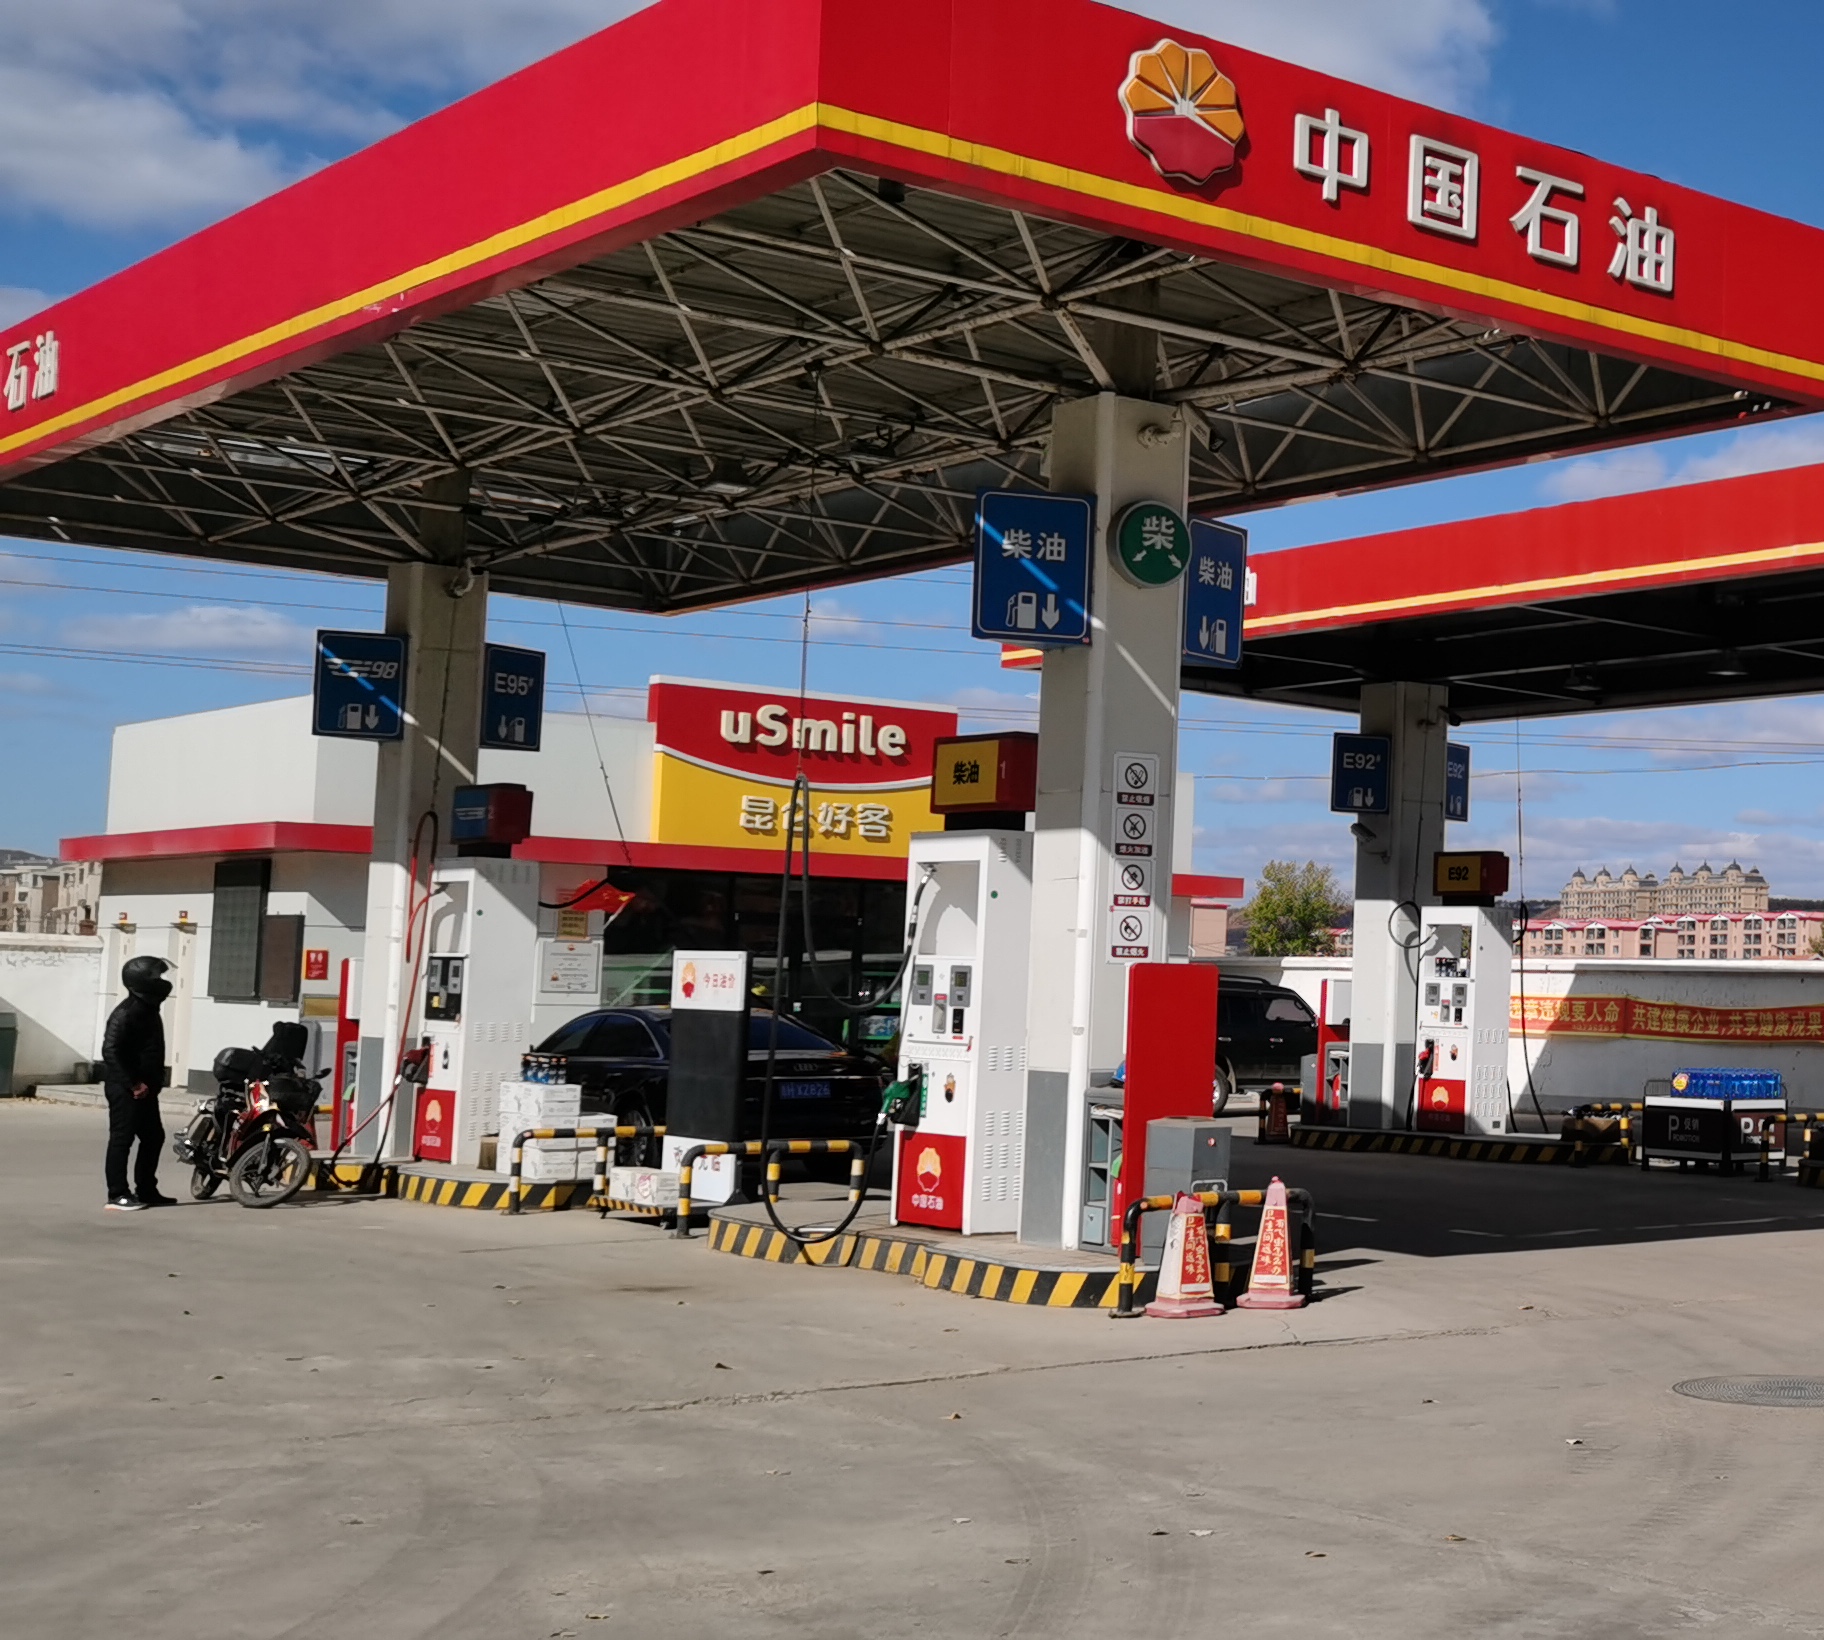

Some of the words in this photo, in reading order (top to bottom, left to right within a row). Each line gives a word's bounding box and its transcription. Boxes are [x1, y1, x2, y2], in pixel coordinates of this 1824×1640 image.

[1293, 108, 1676, 293] 中国石油
[3, 330, 59, 411] 石油
[1001, 529, 1066, 562] 柴油
[1141, 515, 1175, 550] 柴
[1197, 555, 1232, 591] 柴油
[720, 704, 907, 756] uSmile
[953, 760, 979, 785] 柴油
[1000, 760, 1006, 779] 1
[740, 794, 892, 838] 昆仑好客
[1448, 866, 1470, 881] E92
[911, 1193, 944, 1211] 中国石油
